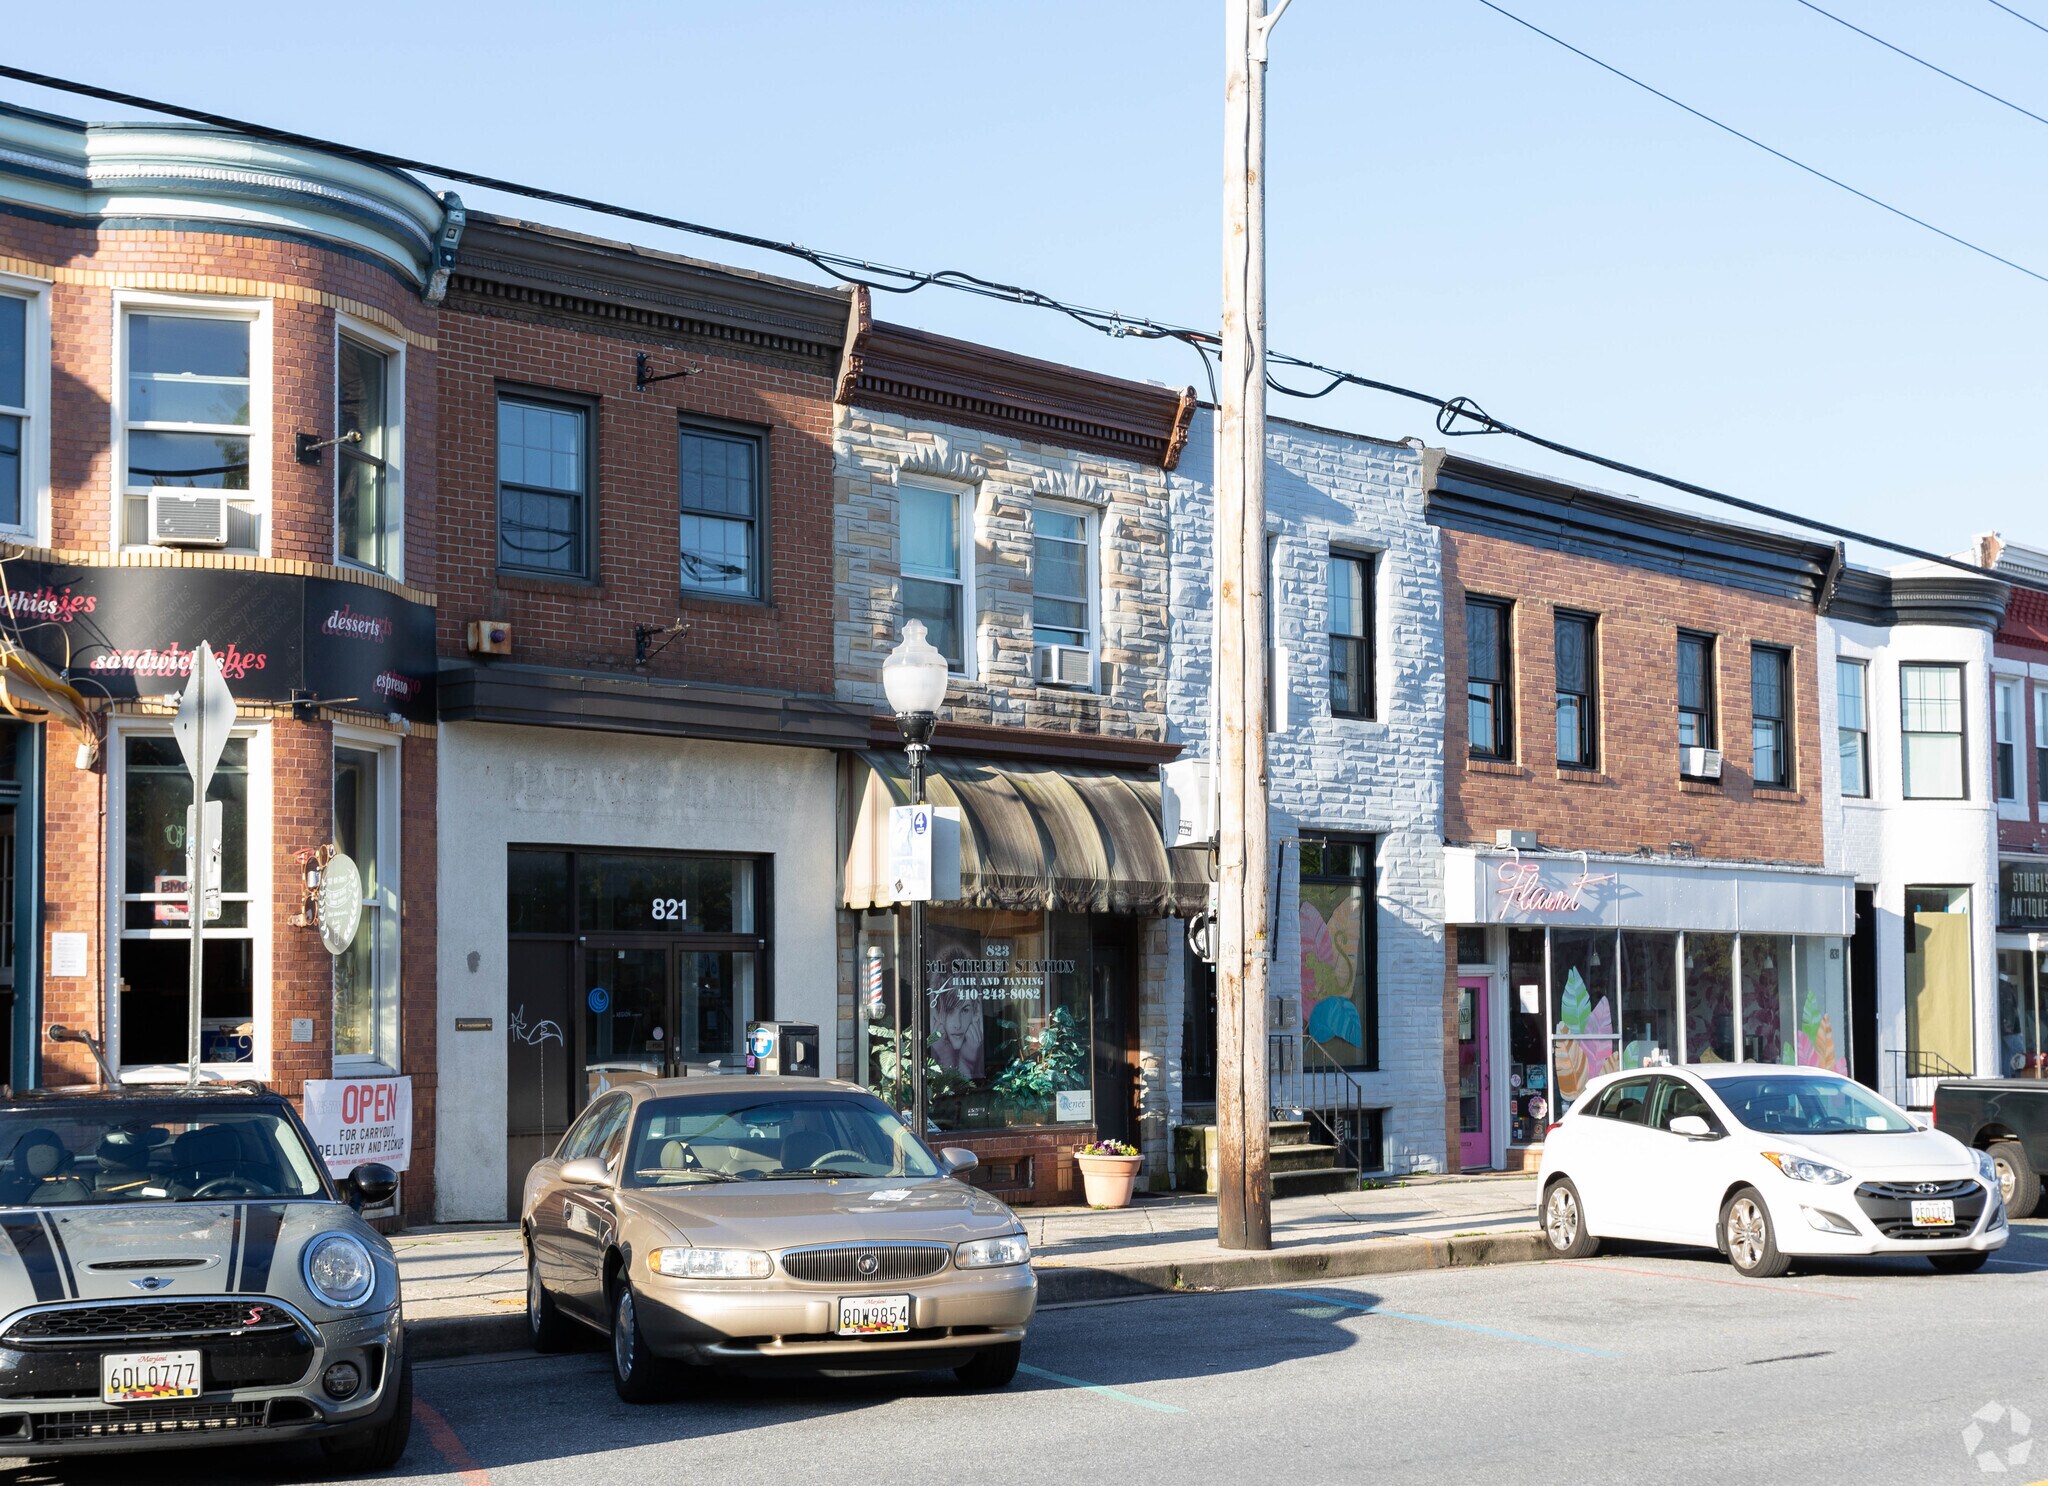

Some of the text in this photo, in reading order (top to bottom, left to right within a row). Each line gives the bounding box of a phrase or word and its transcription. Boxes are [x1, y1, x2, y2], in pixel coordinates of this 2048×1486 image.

[328, 610, 380, 636] desserts
[96, 650, 225, 671] sandwics
[377, 674, 408, 695] espresso
[915, 812, 924, 827] 4
[1498, 862, 1615, 920] Flaunt
[652, 898, 687, 920] 821
[986, 945, 1010, 957] 823
[951, 959, 1010, 974] STREET
[1015, 959, 1076, 974] STATION
[952, 977, 1044, 986] HAIR AND TANNING
[957, 988, 1041, 1000] 410-243-8082
[342, 1083, 398, 1124] OPEN
[340, 1125, 396, 1141] FOR CARRYOUT,
[318, 1138, 404, 1157] DELIVERY AND PICKUP
[843, 1306, 907, 1327] 8DW9854
[137, 1354, 168, 1364] Maryland
[110, 1363, 195, 1390] 6DL0777
